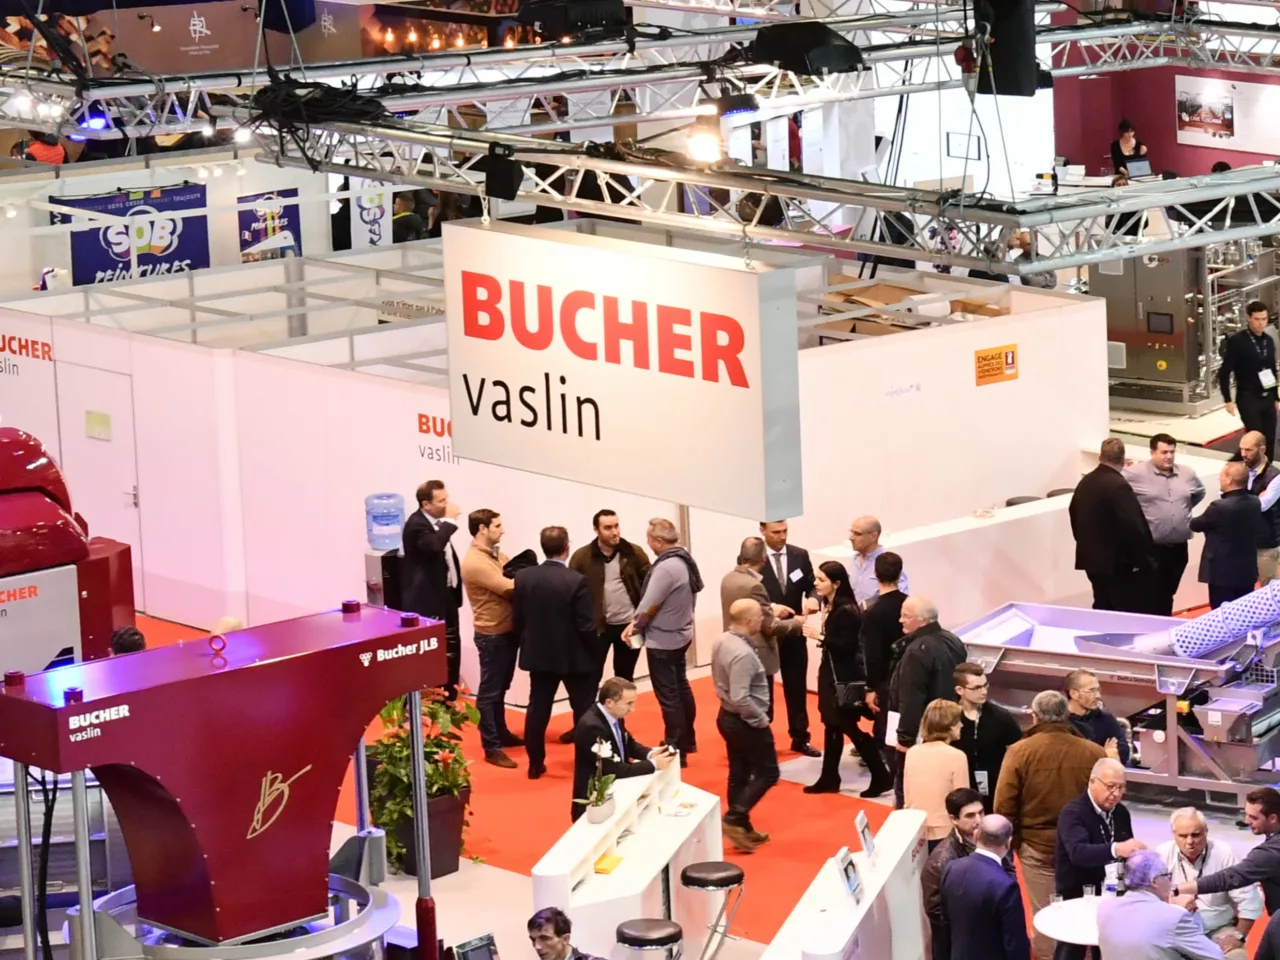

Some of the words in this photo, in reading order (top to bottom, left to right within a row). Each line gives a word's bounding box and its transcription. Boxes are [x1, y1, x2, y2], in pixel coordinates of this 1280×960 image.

[108, 202, 124, 210] sans
[173, 193, 200, 202] toujours
[461, 270, 750, 389] BUCHER
[462, 372, 601, 441] vaslin
[377, 643, 418, 661] Bucher
[419, 637, 438, 655] JLB
[69, 704, 130, 729] BUCHER
[69, 727, 101, 742] vaslin
